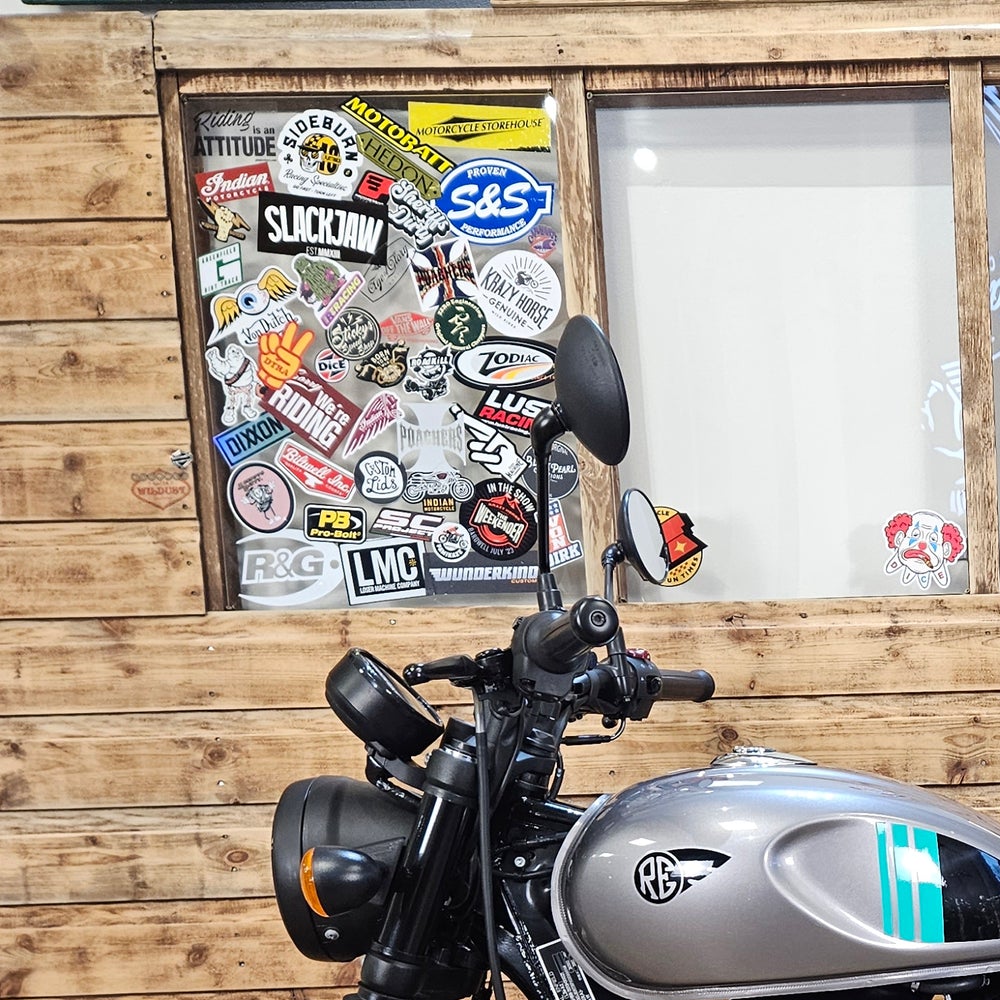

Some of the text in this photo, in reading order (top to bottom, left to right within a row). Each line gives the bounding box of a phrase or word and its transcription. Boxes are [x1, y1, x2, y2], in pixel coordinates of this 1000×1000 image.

[195, 109, 256, 132] Riding
[346, 97, 454, 173] MOTOBATT
[416, 118, 544, 137] MOTORCYCLE STOREHOUSE
[195, 136, 276, 157] ATTITUDE
[283, 114, 359, 162] SIDEBURN
[364, 138, 434, 195] HEDON
[467, 166, 507, 179] PROVEN
[201, 171, 270, 197] Indian
[205, 185, 270, 203] MOTORCYCLE
[448, 182, 532, 220] S&S
[264, 205, 384, 255] SLACKJAW
[389, 205, 434, 248] Dirty
[460, 218, 527, 238] PERFORMANCE
[306, 246, 317, 256] EST
[480, 266, 553, 330] KRAZY HORSE
[489, 296, 526, 329] GENUINE
[241, 307, 299, 345] Von Dutch
[371, 349, 391, 364] BORN
[479, 351, 541, 376] ZODIAC
[268, 386, 342, 449] RIDING
[315, 391, 351, 426] We're
[225, 417, 284, 457] DIXXON
[400, 425, 464, 450] POACHERS
[283, 447, 330, 479] Biltwell
[551, 463, 576, 474] PEARL
[367, 477, 398, 493] Lids
[487, 482, 536, 512] IN THE SHOW
[318, 510, 351, 529] PB
[474, 502, 525, 542] WEEKENDER
[245, 549, 325, 580] R&G
[353, 546, 418, 587] LMC
[429, 566, 539, 582] WUNDERKIND
[681, 557, 698, 578] TIMES
